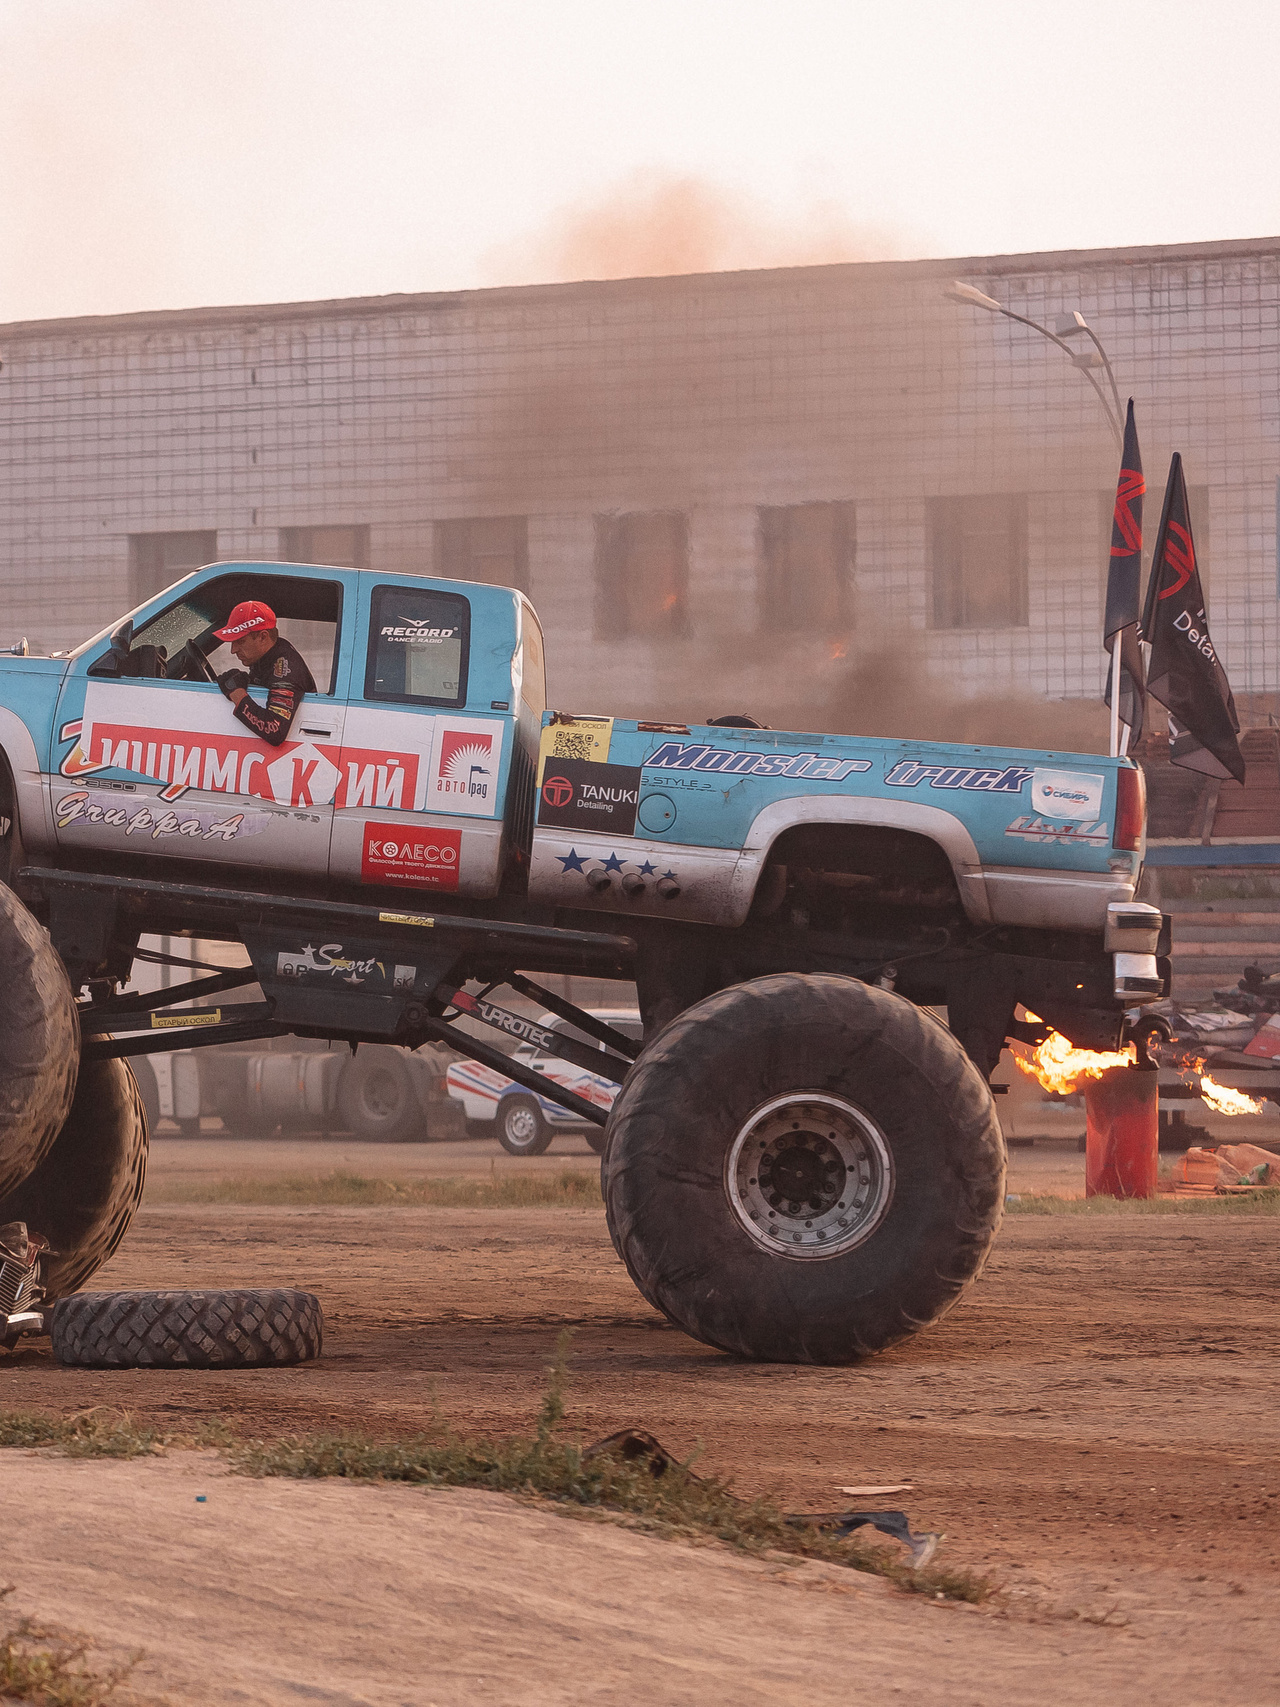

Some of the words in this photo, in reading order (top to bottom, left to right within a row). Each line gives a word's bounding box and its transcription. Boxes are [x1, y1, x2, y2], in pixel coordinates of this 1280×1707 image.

[222, 616, 265, 635] HONDA
[381, 626, 454, 638] RECORD
[642, 741, 873, 781] Monster
[883, 760, 1035, 793] truck
[86, 778, 136, 792] 3500
[653, 777, 699, 788] STYLE
[580, 784, 638, 804] TANUKI
[577, 799, 614, 813] Detailing
[56, 792, 203, 839] Gruppa
[368, 840, 457, 864] КОЛЕСО
[157, 1018, 188, 1027] СТАРЫЙ
[189, 1016, 216, 1024] ОСКОЛ
